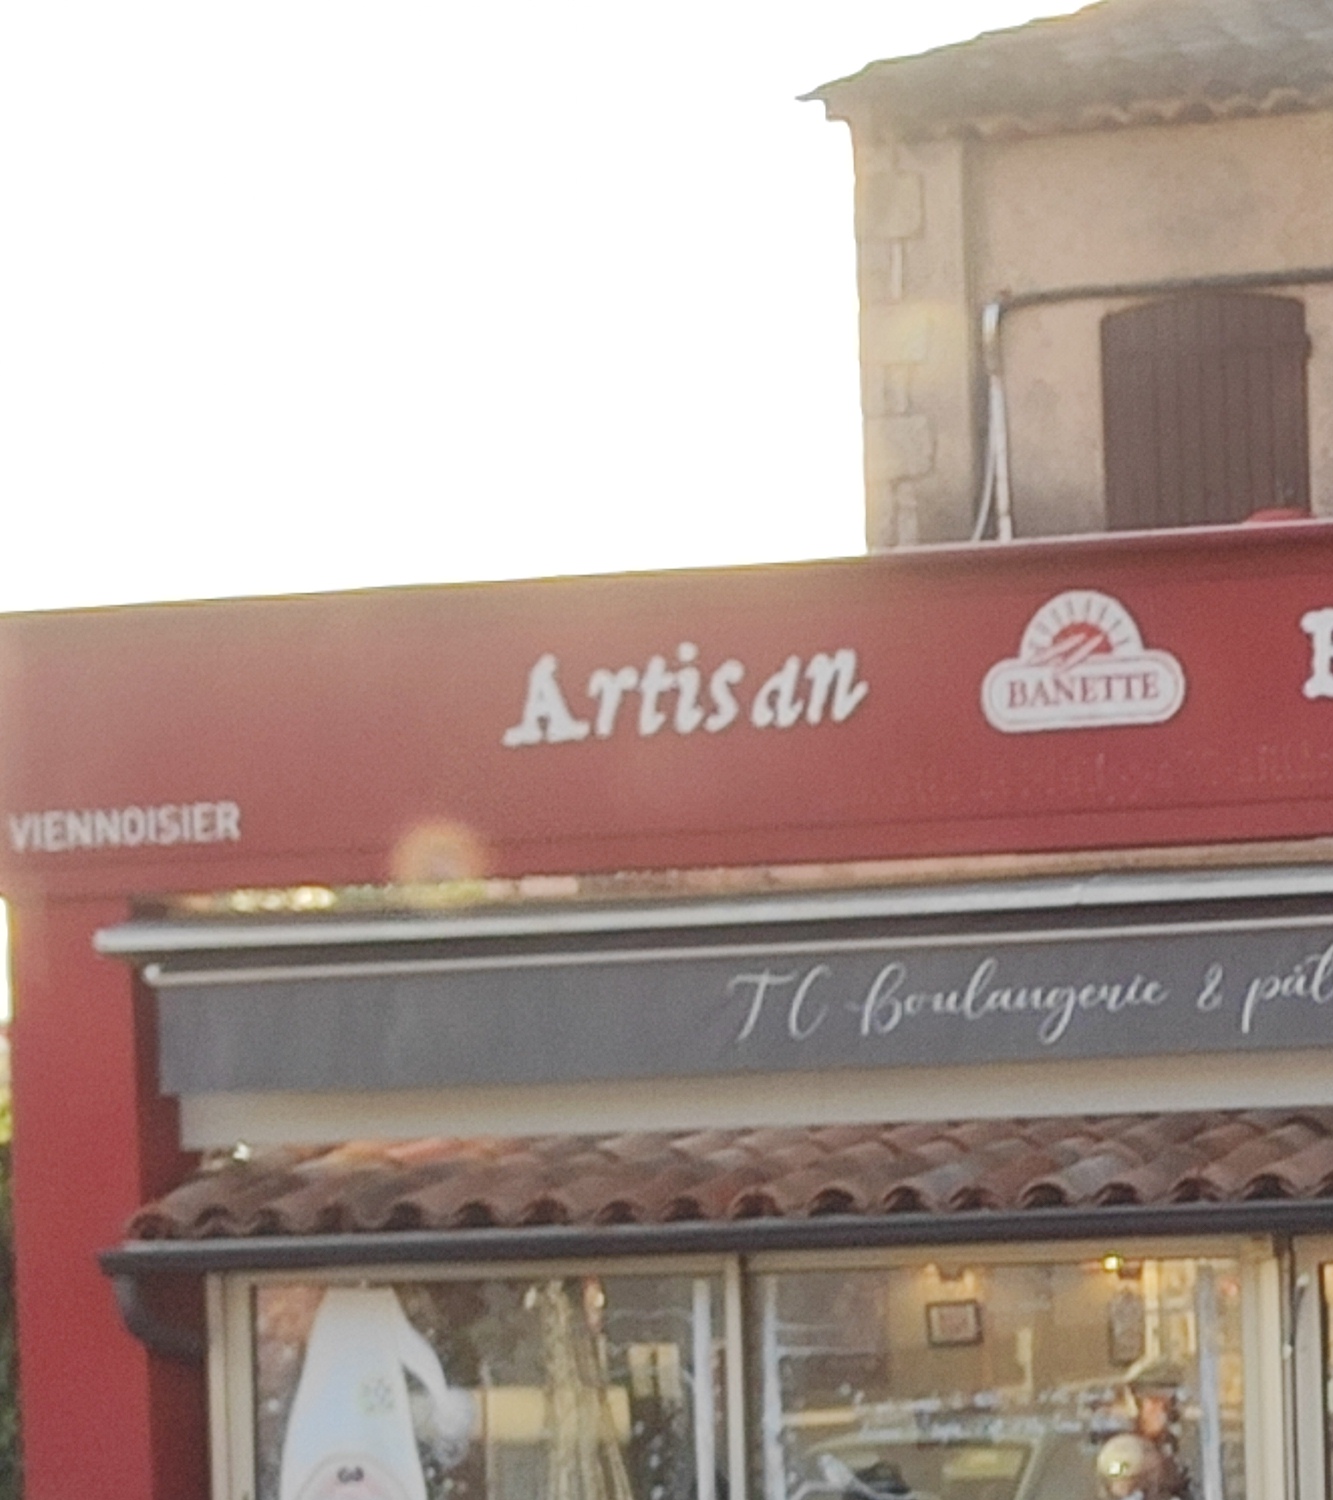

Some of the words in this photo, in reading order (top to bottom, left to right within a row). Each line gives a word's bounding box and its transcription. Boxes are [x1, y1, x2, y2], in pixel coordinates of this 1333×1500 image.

[502, 642, 869, 747] Artisan
[1007, 671, 1161, 711] BANETTE
[8, 801, 242, 852] VIENNOISIER
